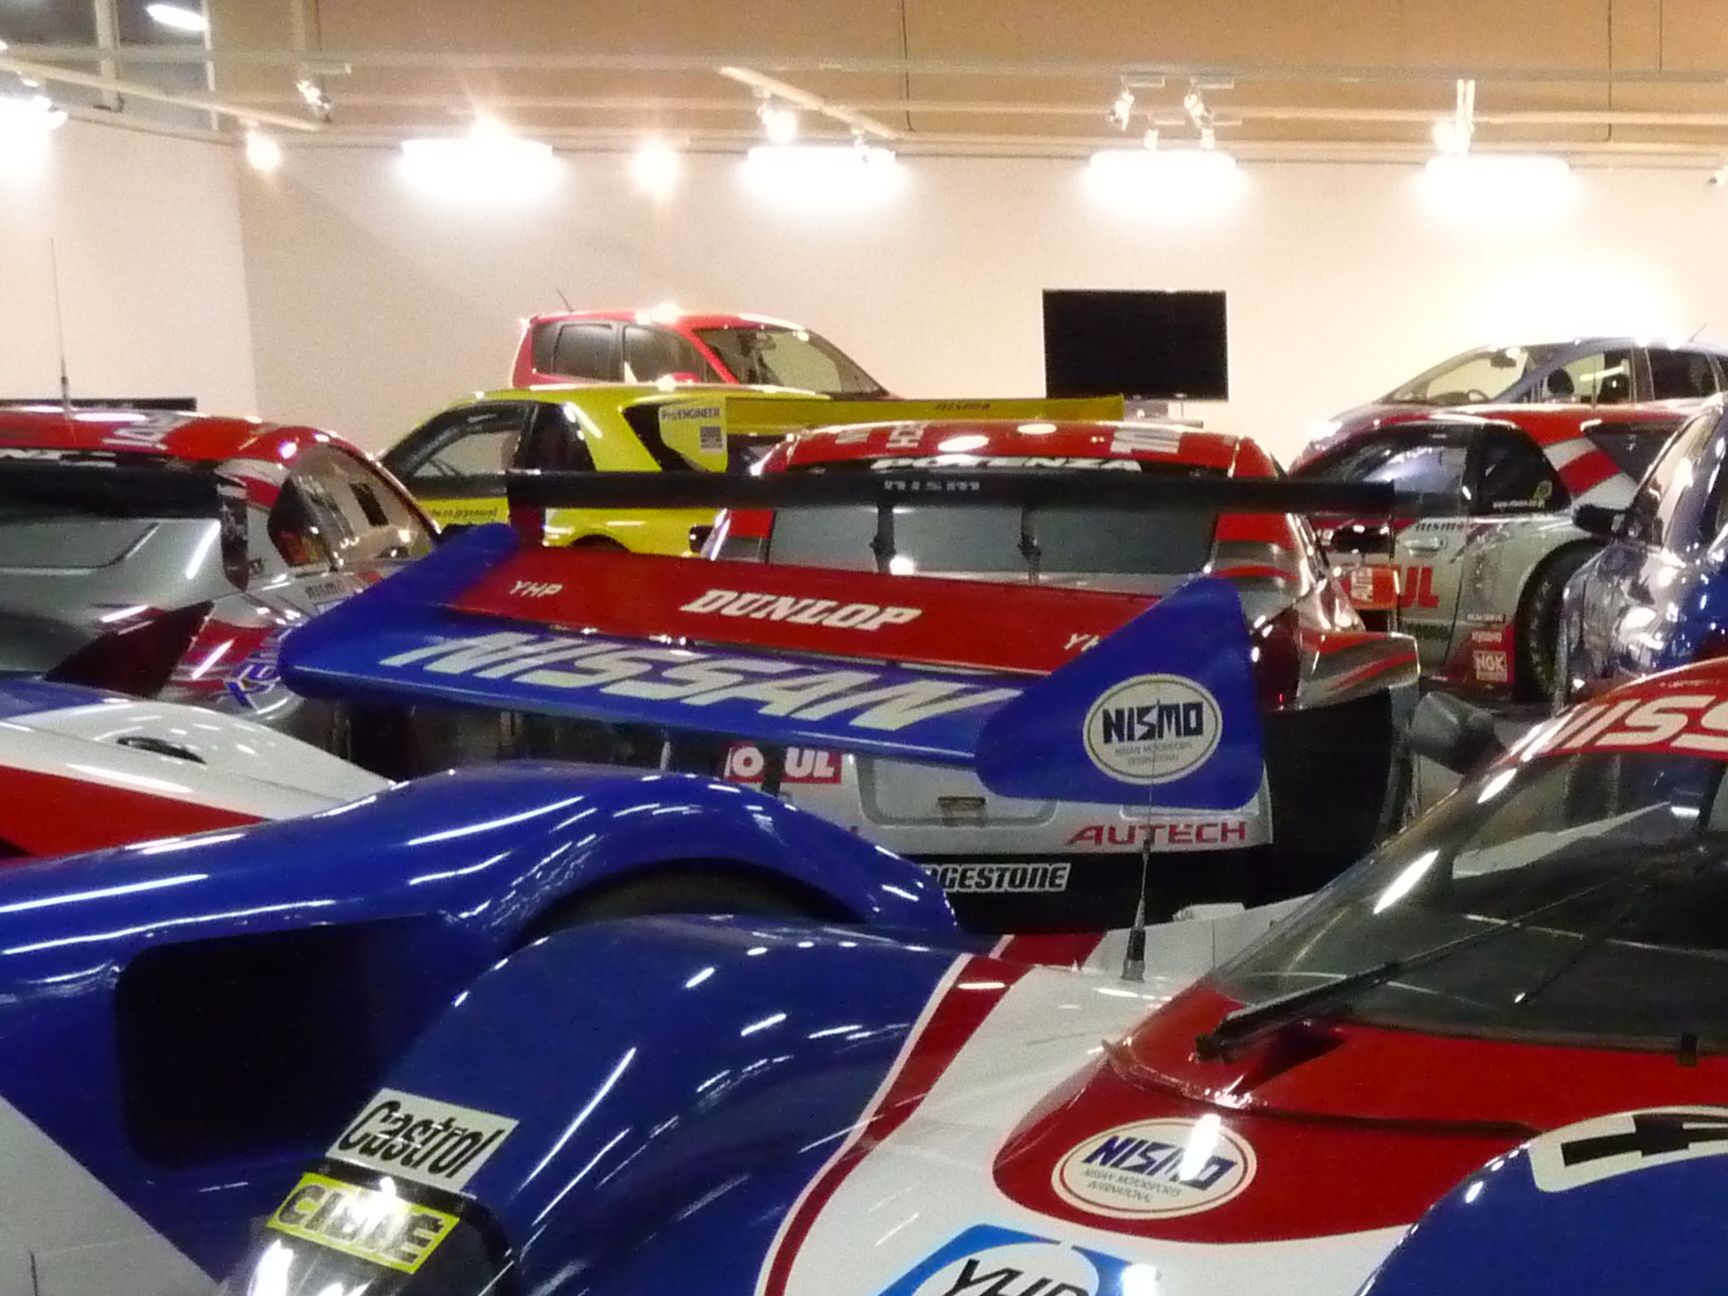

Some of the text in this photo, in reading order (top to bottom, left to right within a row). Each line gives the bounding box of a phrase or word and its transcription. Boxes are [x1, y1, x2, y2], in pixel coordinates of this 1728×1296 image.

[510, 580, 564, 598] YHP
[680, 588, 923, 633] DUNLOP
[380, 631, 1023, 732] NISSAN
[1102, 701, 1204, 744] NISMO
[1064, 822, 1247, 847] AUTECH
[338, 1099, 506, 1179] Castrol
